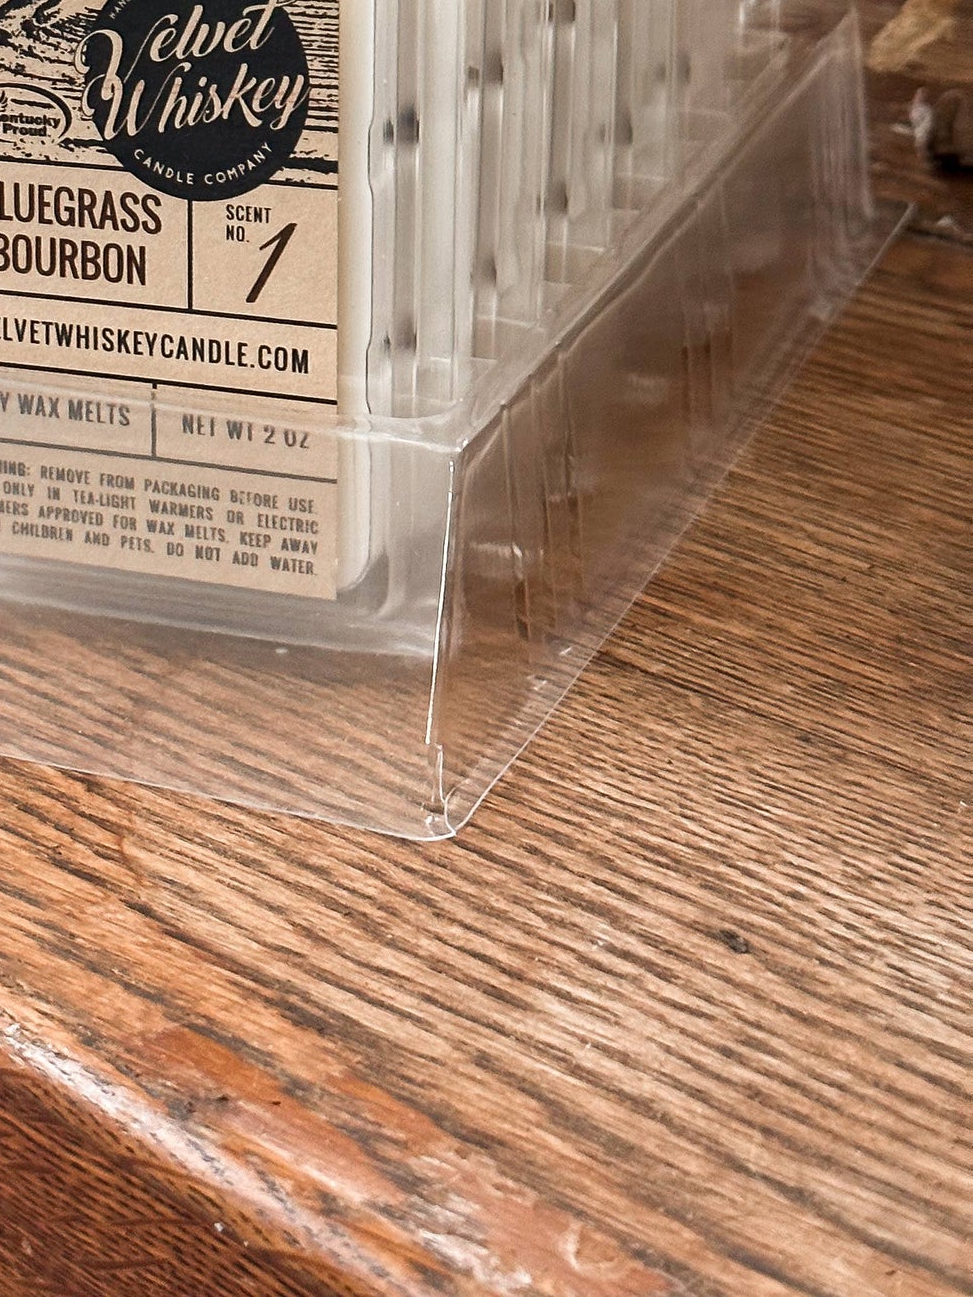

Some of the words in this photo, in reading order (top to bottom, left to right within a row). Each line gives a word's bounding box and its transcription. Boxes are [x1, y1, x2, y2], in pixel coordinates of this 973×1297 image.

[81, 62, 311, 140] Whiskey
[133, 148, 195, 185] CANDLE
[204, 141, 273, 185] COMPANY
[226, 204, 272, 224] SCENT
[226, 225, 250, 243] NO.
[246, 223, 298, 303] 1
[18, 393, 60, 419] WAX
[68, 399, 130, 426] MELTS
[263, 425, 275, 444] 2
[3, 481, 35, 497] ONLY
[47, 487, 60, 501] IN
[73, 489, 136, 510] TEA-LIGHT
[149, 499, 213, 521] WARMERS
[227, 510, 244, 525] OR
[257, 513, 319, 535] ELECTRIC
[40, 465, 90, 485] REMOVE
[99, 473, 135, 491] FROM
[144, 478, 220, 501] PACKAGING
[230, 489, 278, 510] BEFORE
[12, 521, 73, 542] CHILDREN
[84, 531, 110, 546] AND
[167, 542, 184, 557] DO
[195, 545, 221, 562] NOT
[232, 551, 258, 567] ADD
[270, 555, 318, 576] WATER.
[38, 506, 103, 526] APPROVED
[113, 515, 137, 531] FOR
[146, 519, 175, 536] WAX
[240, 531, 271, 549] KEEP
[281, 537, 318, 555] AWAY
